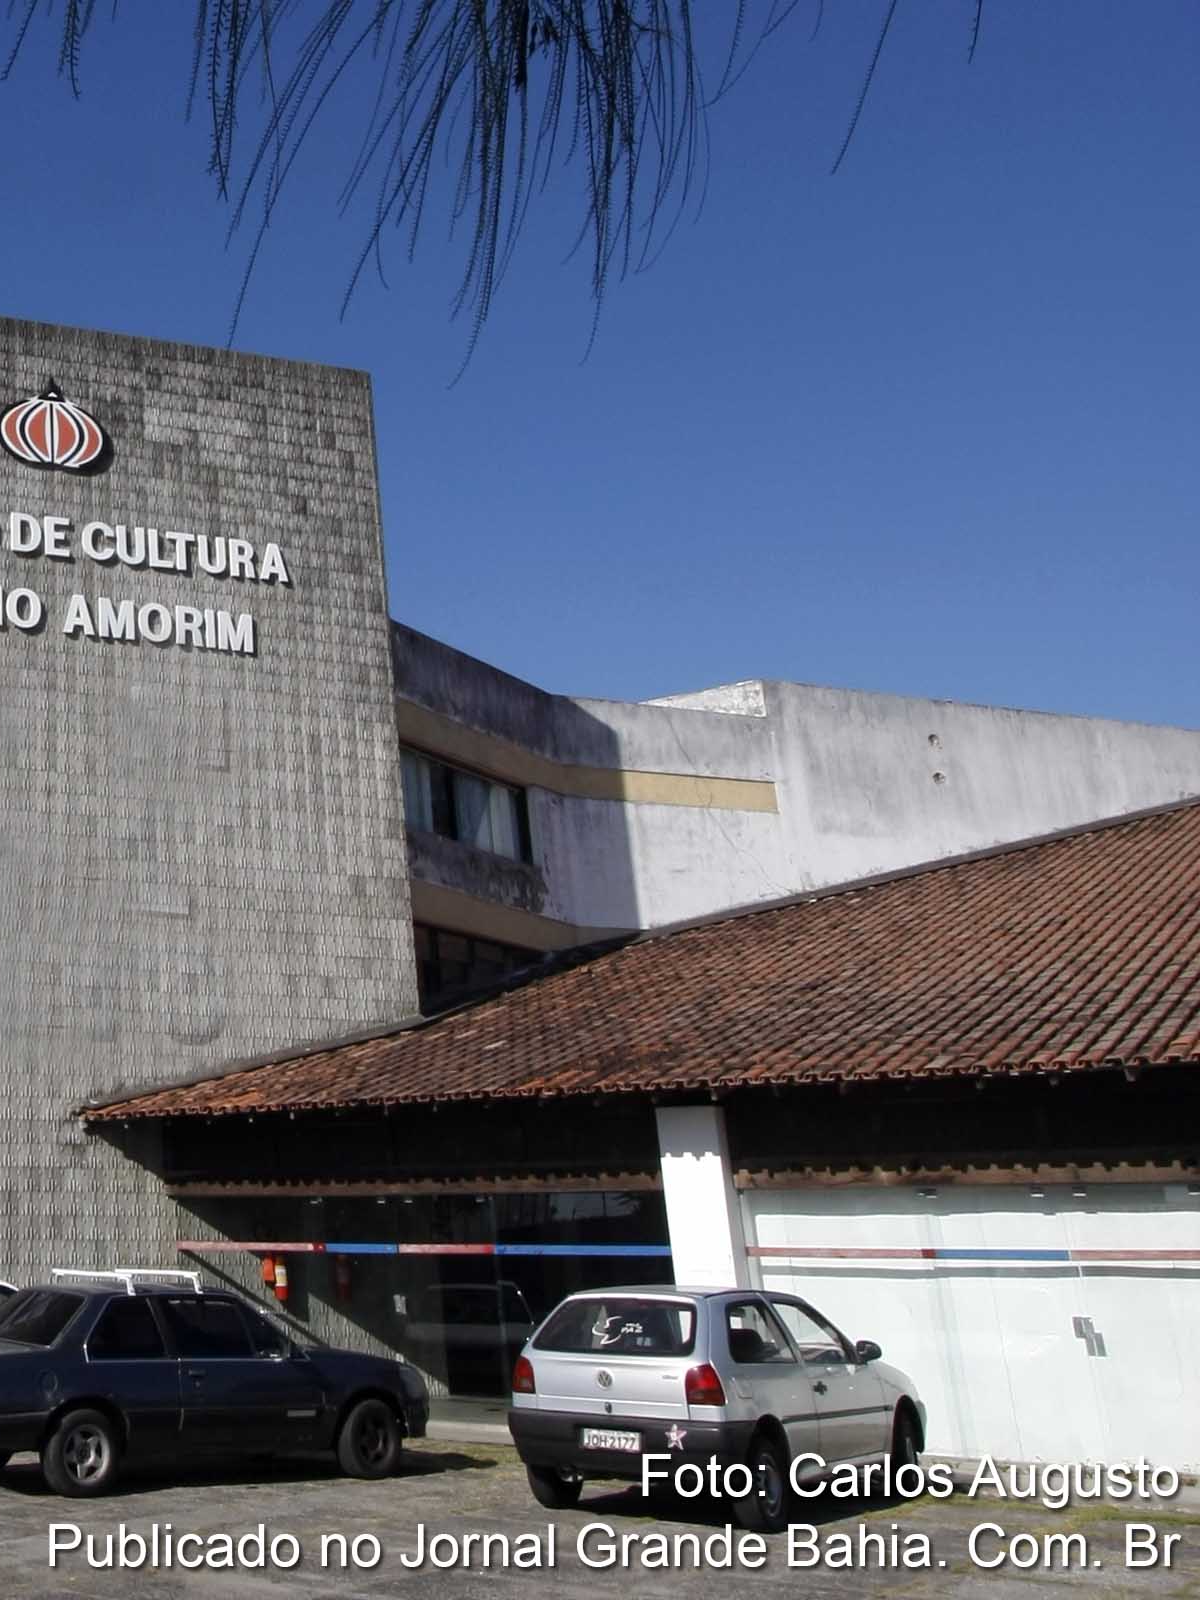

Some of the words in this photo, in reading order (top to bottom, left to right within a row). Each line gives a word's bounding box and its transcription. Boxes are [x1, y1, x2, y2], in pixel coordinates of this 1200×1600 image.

[9, 511, 72, 559] DE
[81, 520, 290, 584] CULTURA
[62, 593, 256, 654] AMORIM
